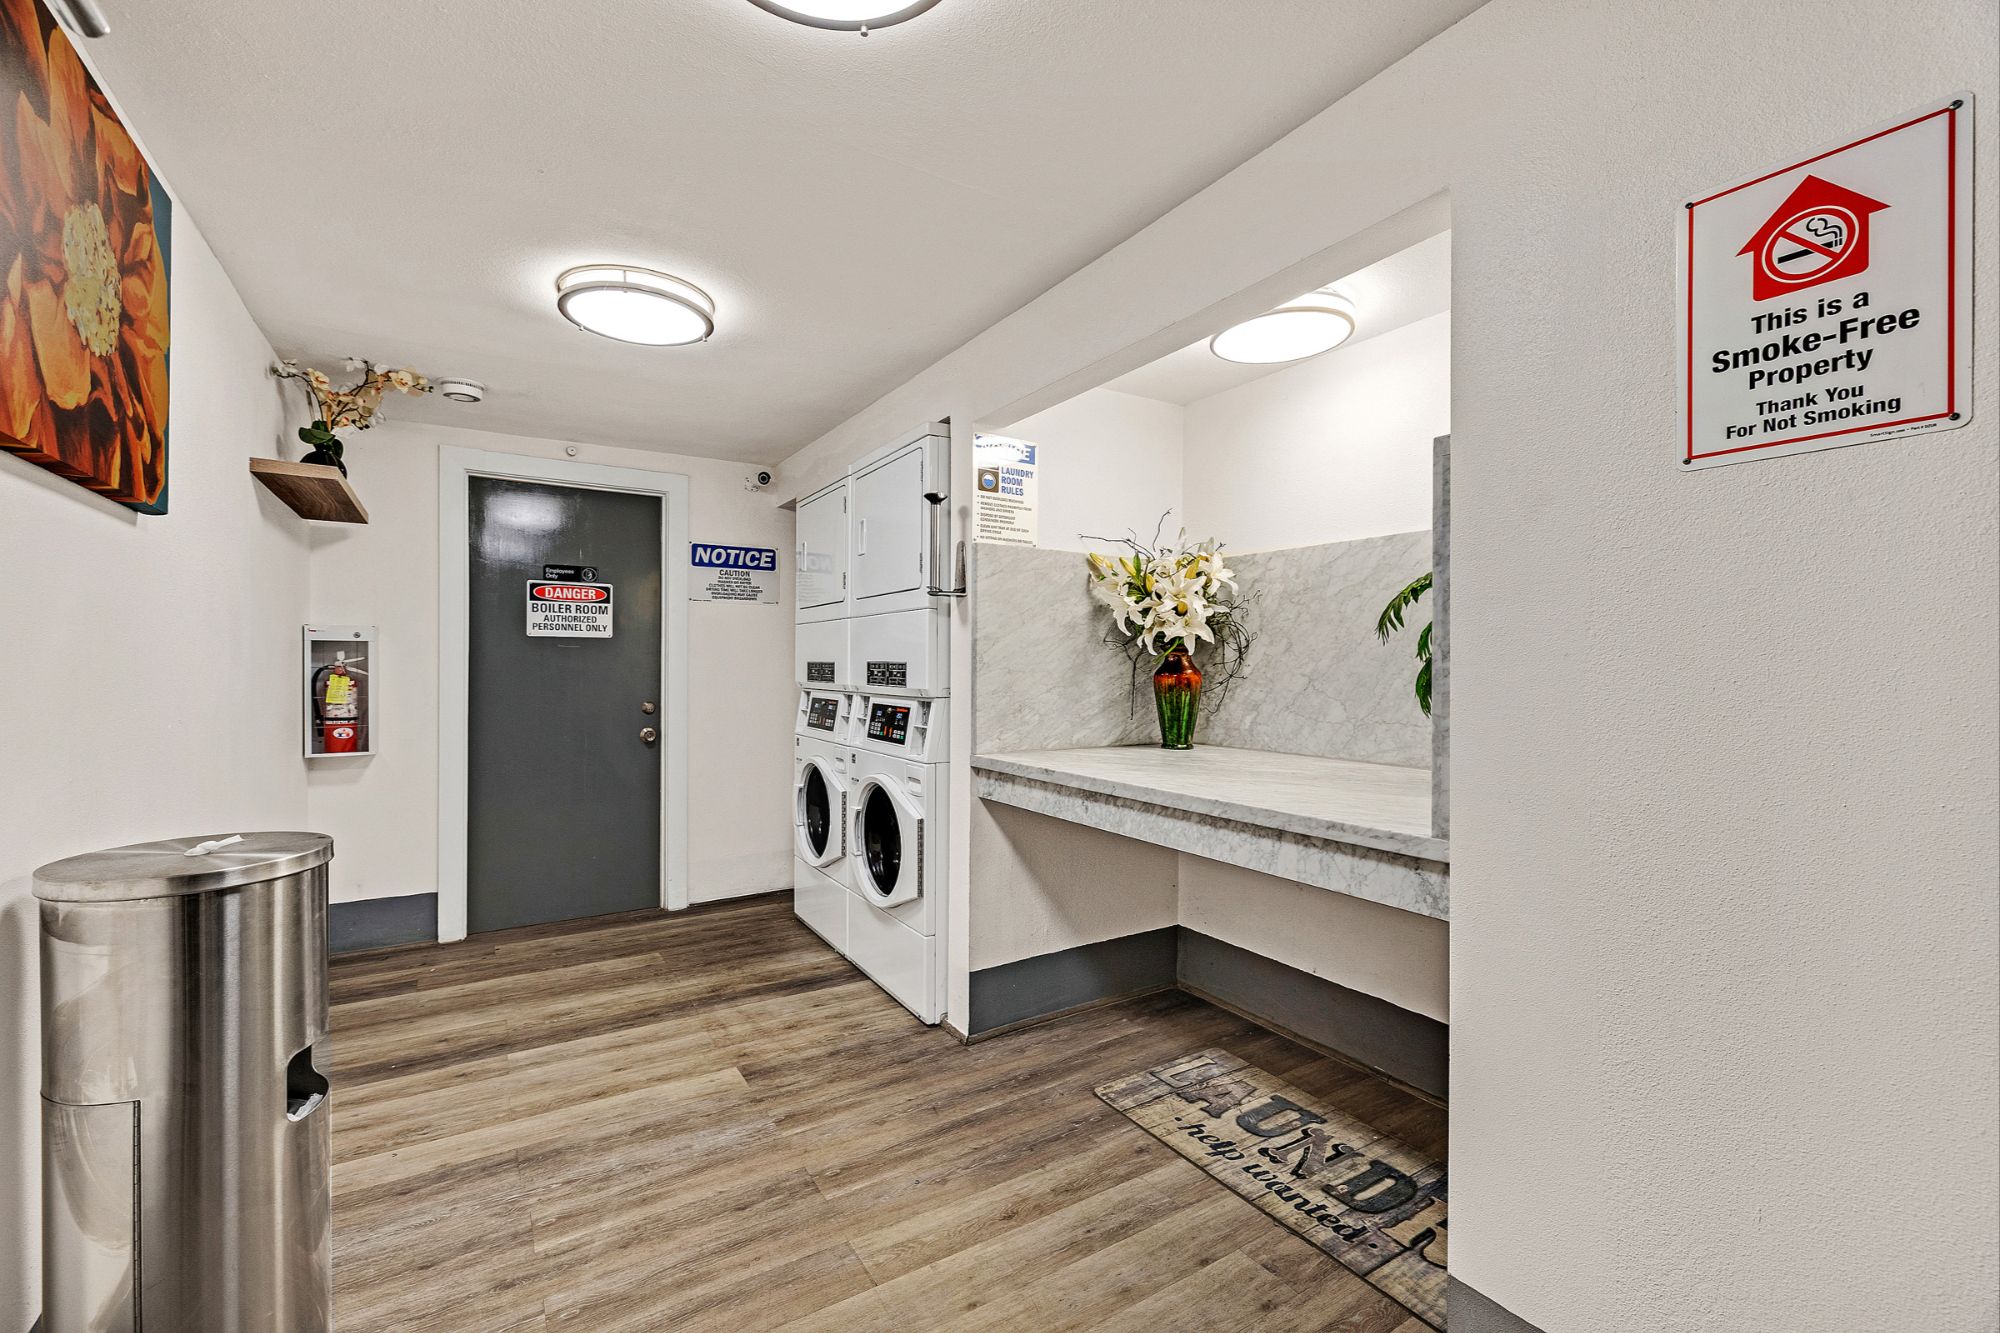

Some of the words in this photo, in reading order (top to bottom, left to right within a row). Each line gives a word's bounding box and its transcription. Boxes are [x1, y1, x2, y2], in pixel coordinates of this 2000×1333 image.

[1751, 307, 1808, 335] This
[1818, 298, 1843, 319] is
[1852, 291, 1870, 310] a
[1711, 307, 1921, 374] Smoke-Free
[1749, 348, 1874, 391] Property
[1756, 392, 1818, 416] Thank
[1825, 384, 1864, 403] You
[1726, 423, 1757, 440] For
[1763, 414, 1798, 433] Not
[1803, 396, 1902, 426] Smoking
[1001, 466, 1034, 479] LAUNDRY
[1001, 475, 1023, 487] ROOM
[1001, 485, 1024, 497] RULES
[695, 546, 774, 568] NOTICE
[545, 567, 575, 575] Employees
[719, 569, 751, 577] CAUTION
[545, 587, 597, 600] DANGER
[531, 602, 572, 614] BOILER
[575, 604, 609, 615] ROOM
[543, 614, 598, 624] AUTHORIZED
[532, 622, 584, 632] PERSONNEL
[585, 624, 608, 632] ONLY
[1178, 1123, 1245, 1161] help
[1242, 1163, 1371, 1244] wanted
